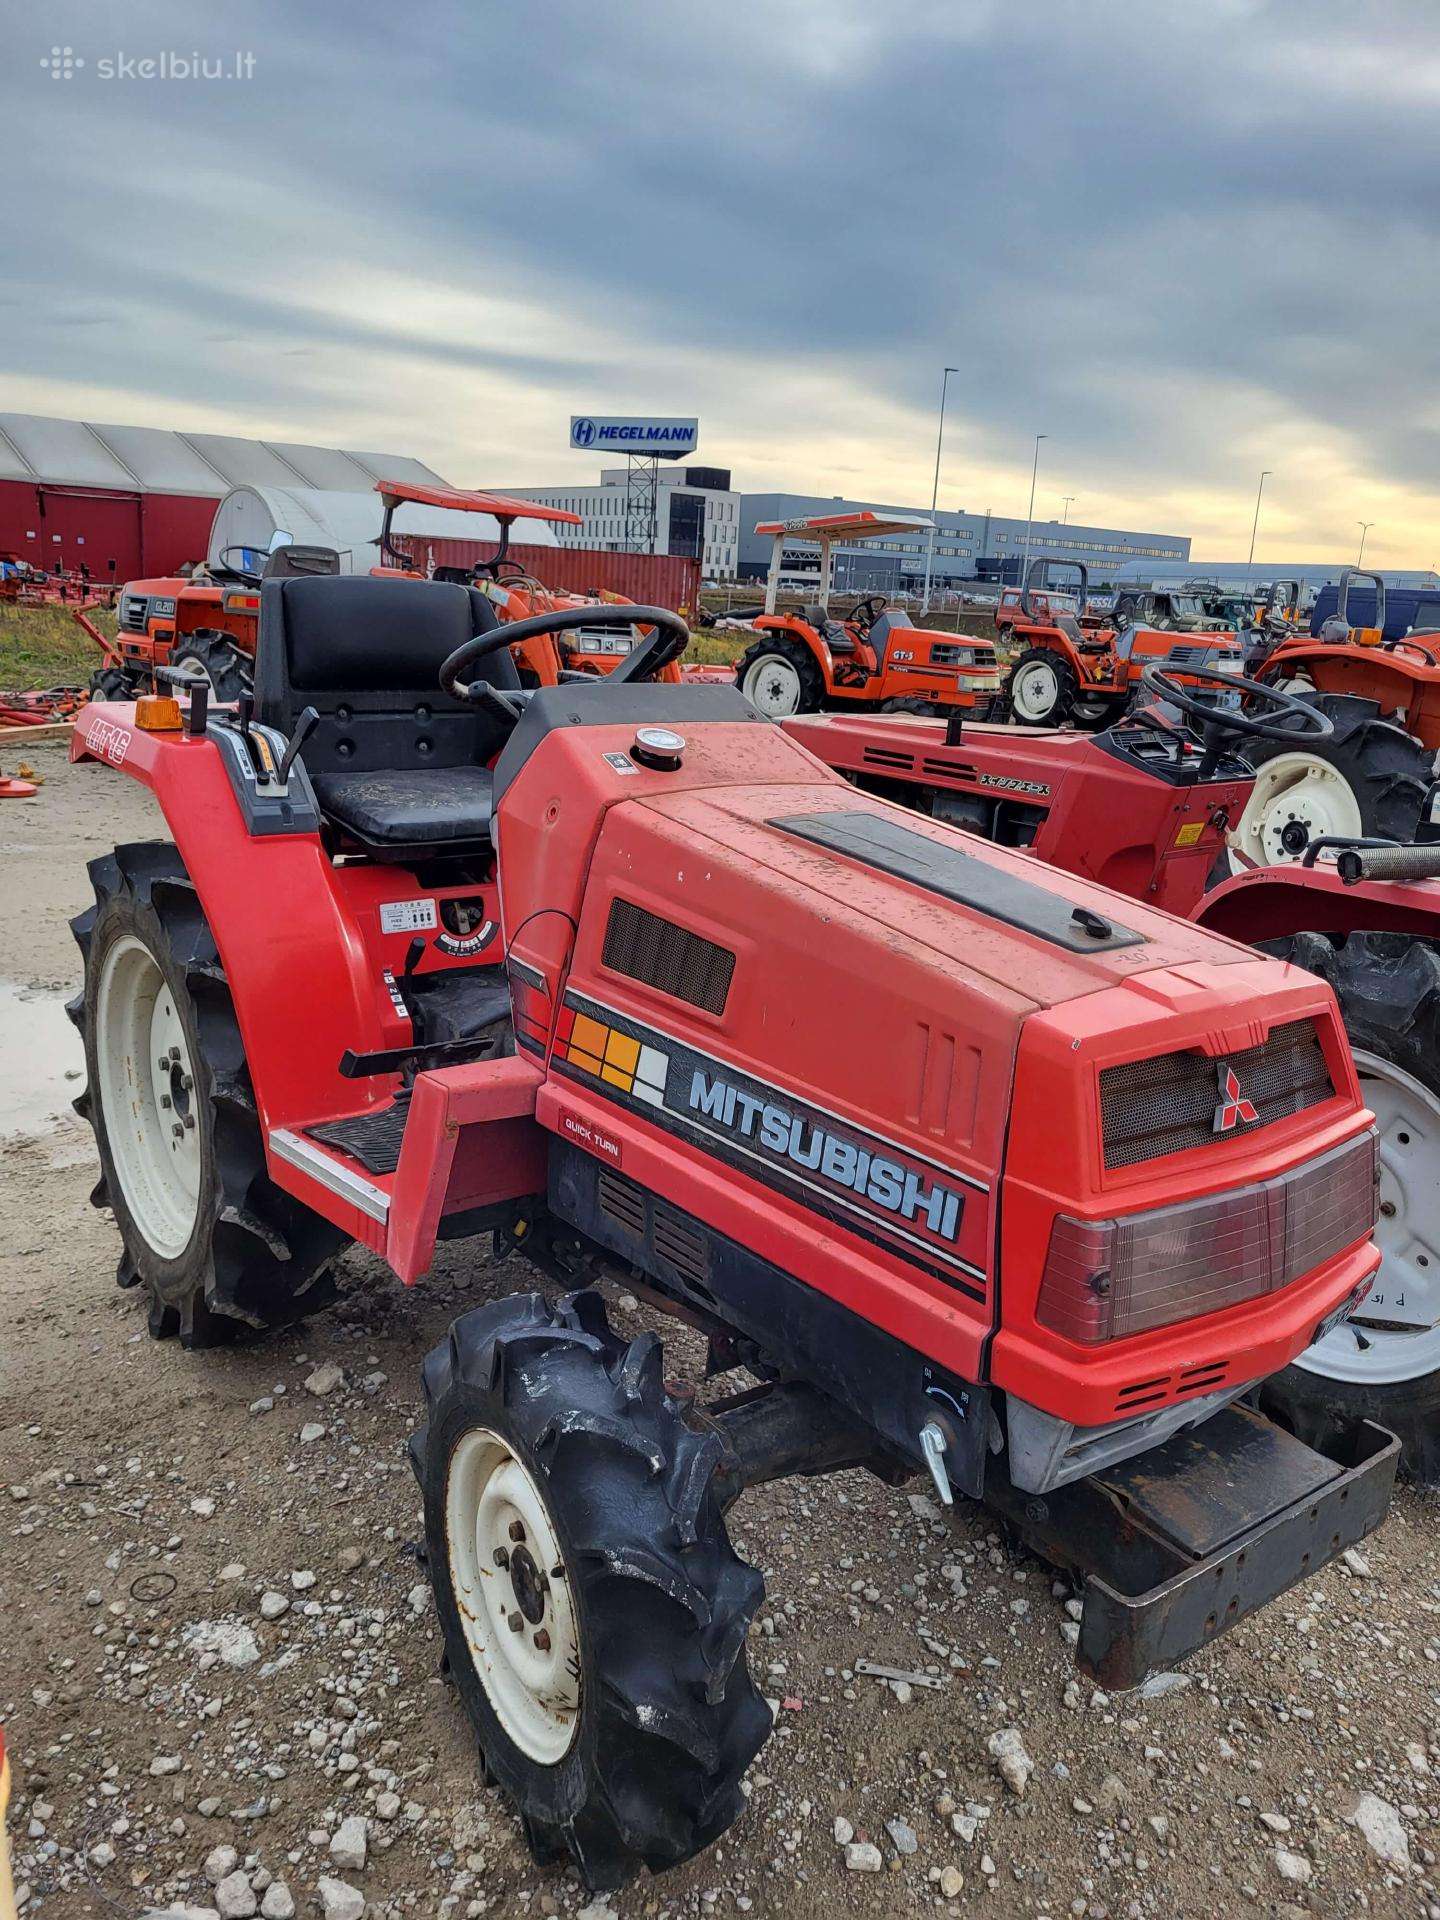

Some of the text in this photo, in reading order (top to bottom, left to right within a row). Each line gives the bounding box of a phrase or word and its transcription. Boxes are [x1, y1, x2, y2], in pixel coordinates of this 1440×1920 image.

[598, 426, 695, 442] HEGELMANN
[565, 1118, 619, 1157] QUICK TURN
[688, 1071, 966, 1243] MITSUBISHI
